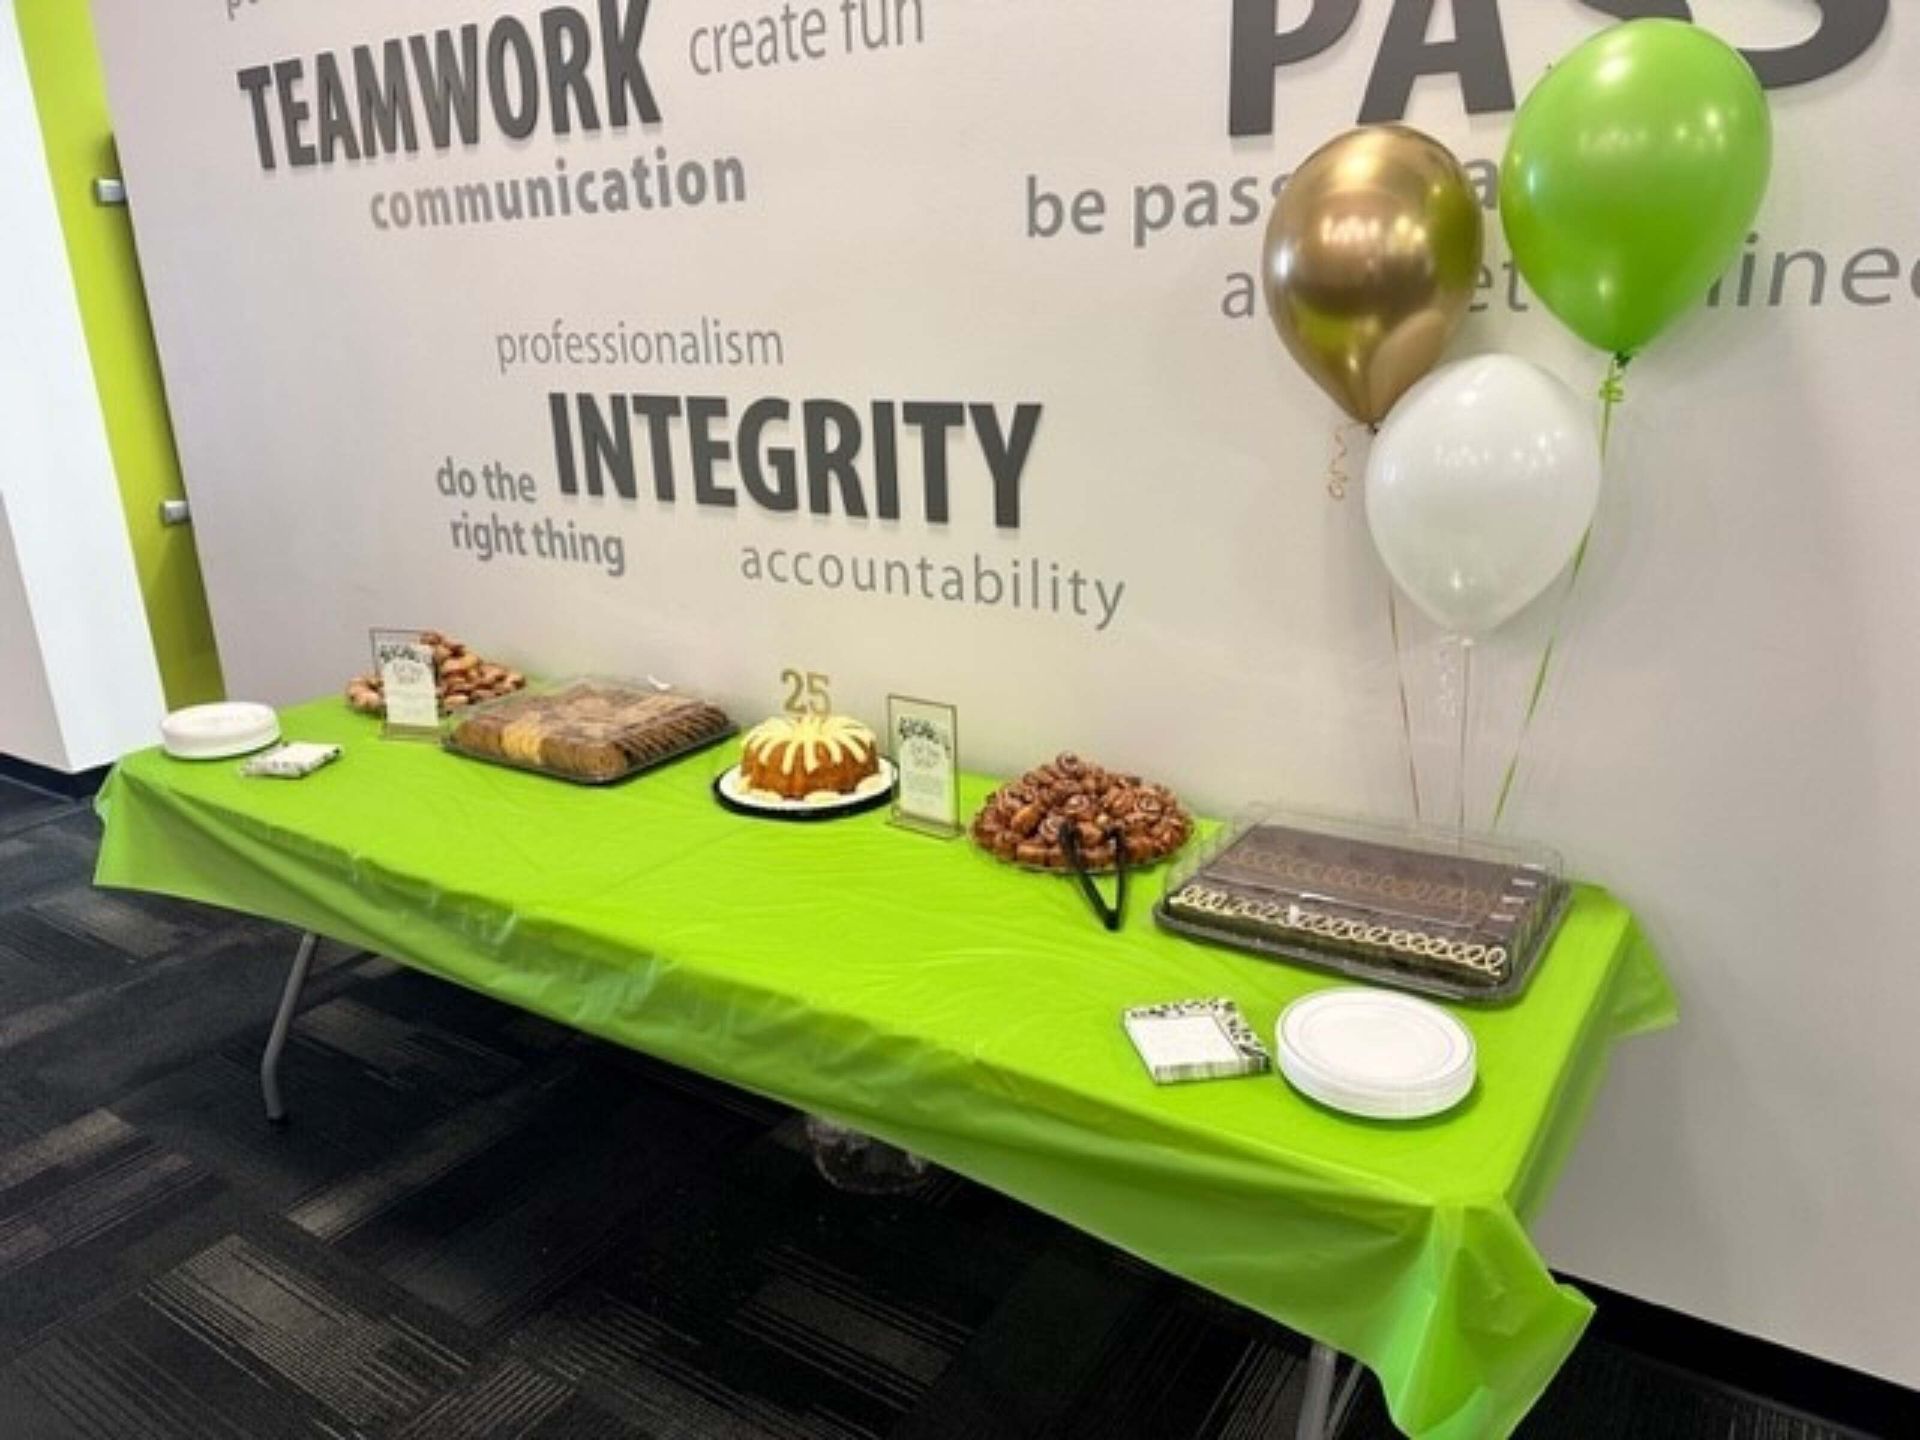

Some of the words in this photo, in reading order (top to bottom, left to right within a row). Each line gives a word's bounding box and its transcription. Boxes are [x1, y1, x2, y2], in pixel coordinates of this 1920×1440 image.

[689, 3, 826, 76] create
[840, 0, 925, 54] fun
[236, 0, 662, 170] TEAMWORK
[370, 147, 746, 230] communication
[1027, 174, 1106, 238] be
[496, 317, 784, 373] professionalism
[436, 455, 478, 497] do
[482, 460, 537, 502] the
[548, 392, 1043, 529] INTEGRITY
[450, 509, 527, 562] right
[531, 516, 625, 577] thing
[741, 546, 1126, 631] accountability
[781, 668, 832, 717] 25
